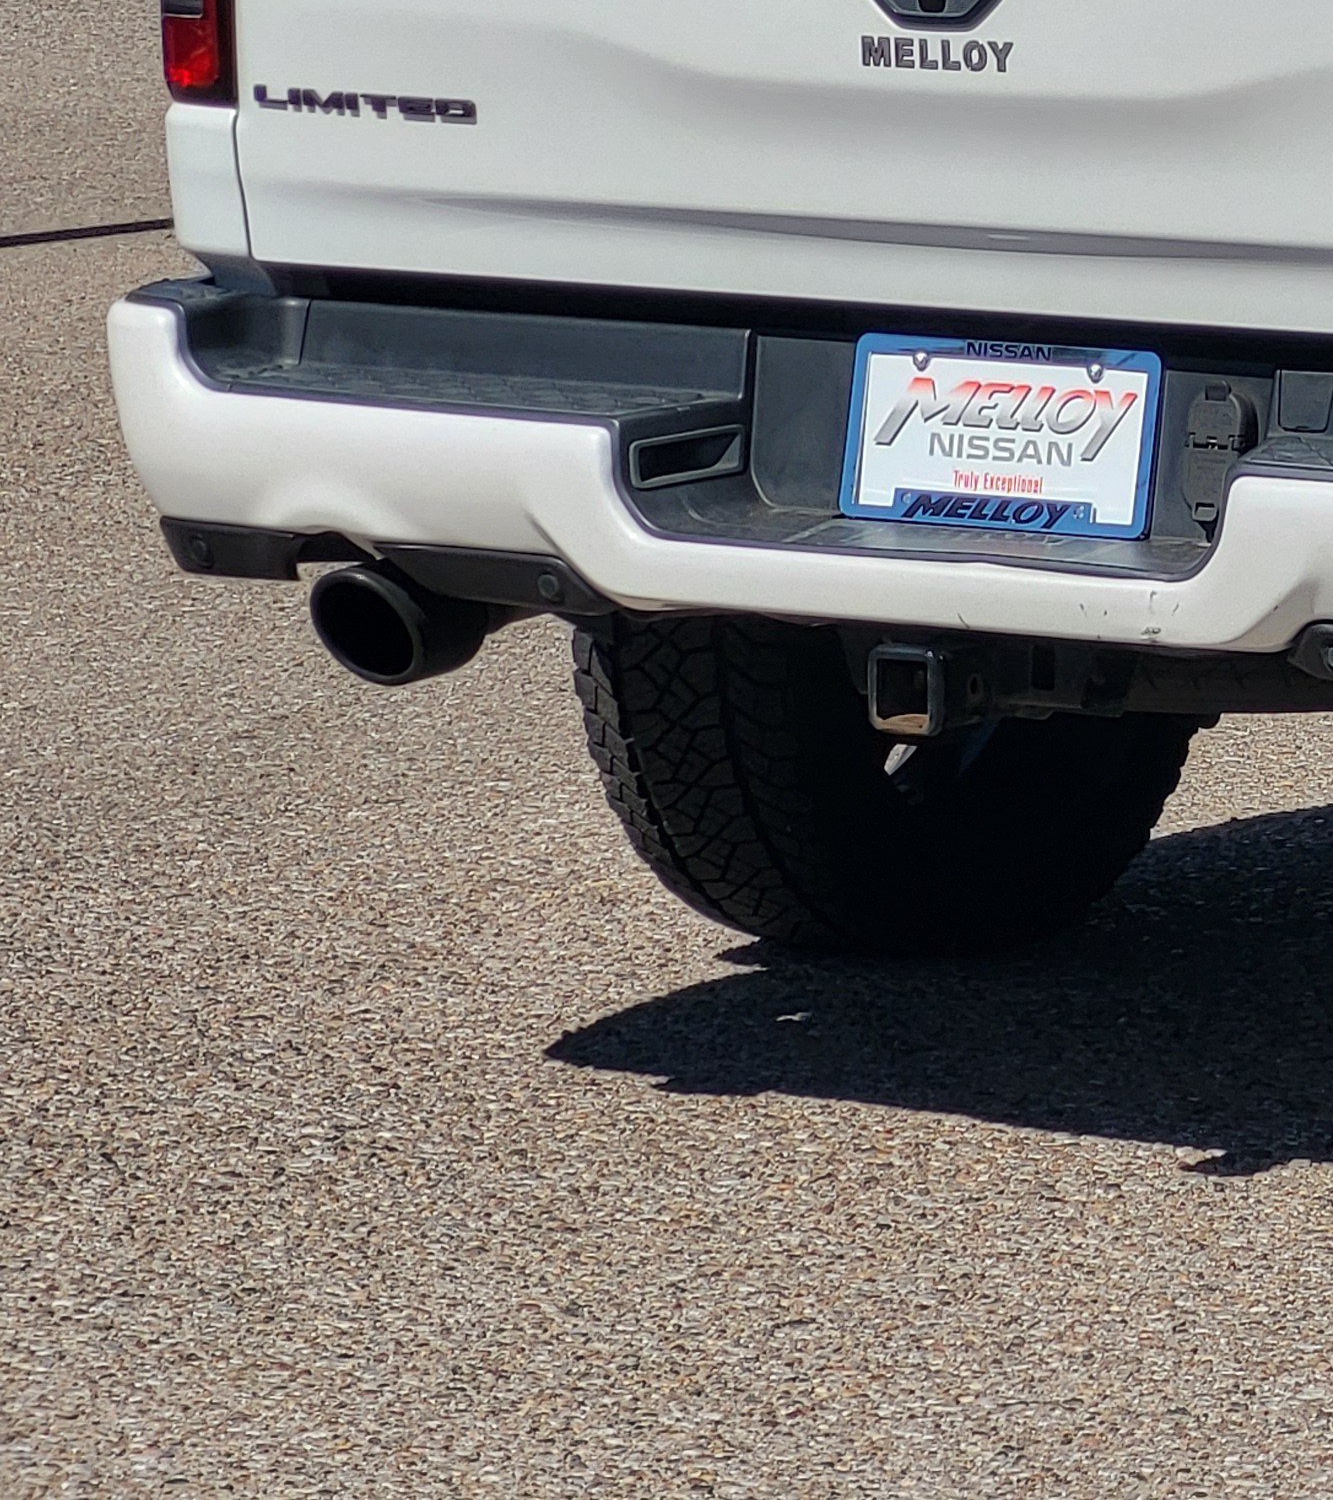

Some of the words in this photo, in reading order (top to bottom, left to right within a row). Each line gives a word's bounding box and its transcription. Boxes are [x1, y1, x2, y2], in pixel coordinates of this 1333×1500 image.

[861, 35, 1014, 73] MELLOY
[253, 84, 477, 125] LIMITED
[965, 340, 1053, 362] NISSAN
[874, 376, 1138, 462] MELLOY
[928, 431, 1074, 467] NISSAN
[953, 469, 979, 491] Truly
[984, 472, 1044, 494] Exceptional
[901, 492, 1073, 529] MELLOY
